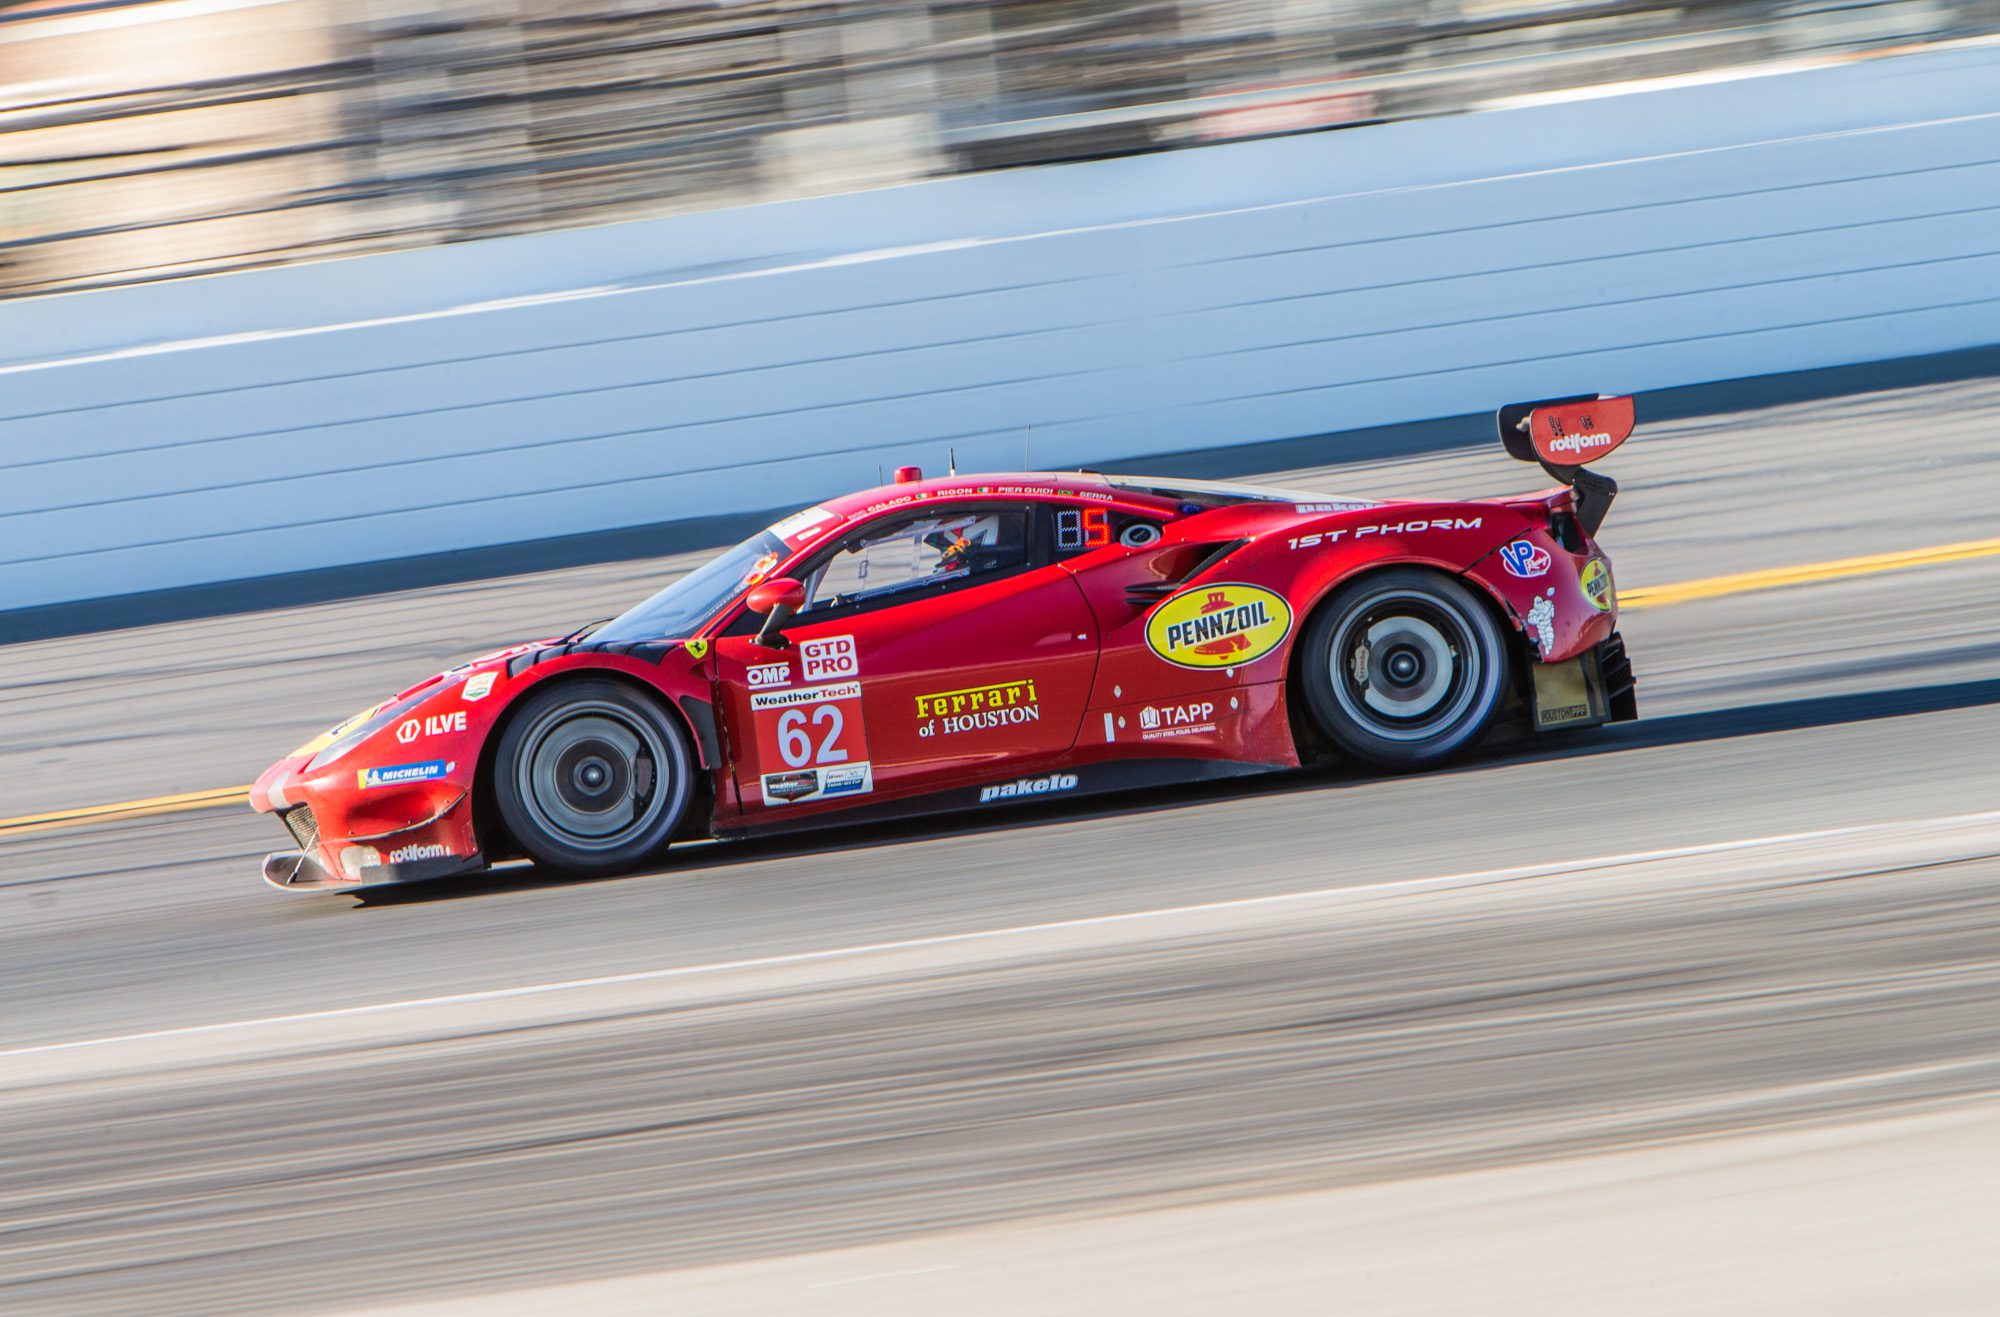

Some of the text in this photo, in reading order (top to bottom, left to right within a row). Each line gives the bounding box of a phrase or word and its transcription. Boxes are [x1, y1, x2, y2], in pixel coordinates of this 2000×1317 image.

[1549, 432, 1611, 454] rotiform
[937, 487, 973, 497] RIGON
[997, 486, 1054, 495] PIER GUIDI
[1079, 490, 1114, 501] SERRA
[867, 495, 912, 512] CALADO
[1288, 517, 1483, 550] 1ST PHORM
[1500, 540, 1535, 576] VP
[1166, 600, 1271, 651] PENNZOIL
[804, 640, 851, 658] GTD
[747, 666, 791, 685] OMP
[806, 656, 853, 676] PRO
[915, 678, 1037, 718] Ferrari
[425, 710, 467, 736] ILVE
[918, 704, 1039, 738] of HOUSTON
[1161, 702, 1214, 725] TAPP
[777, 703, 849, 768] 62
[382, 765, 439, 781] MICHELIN
[980, 774, 1079, 803] pakelo
[389, 843, 445, 863] rotiform
